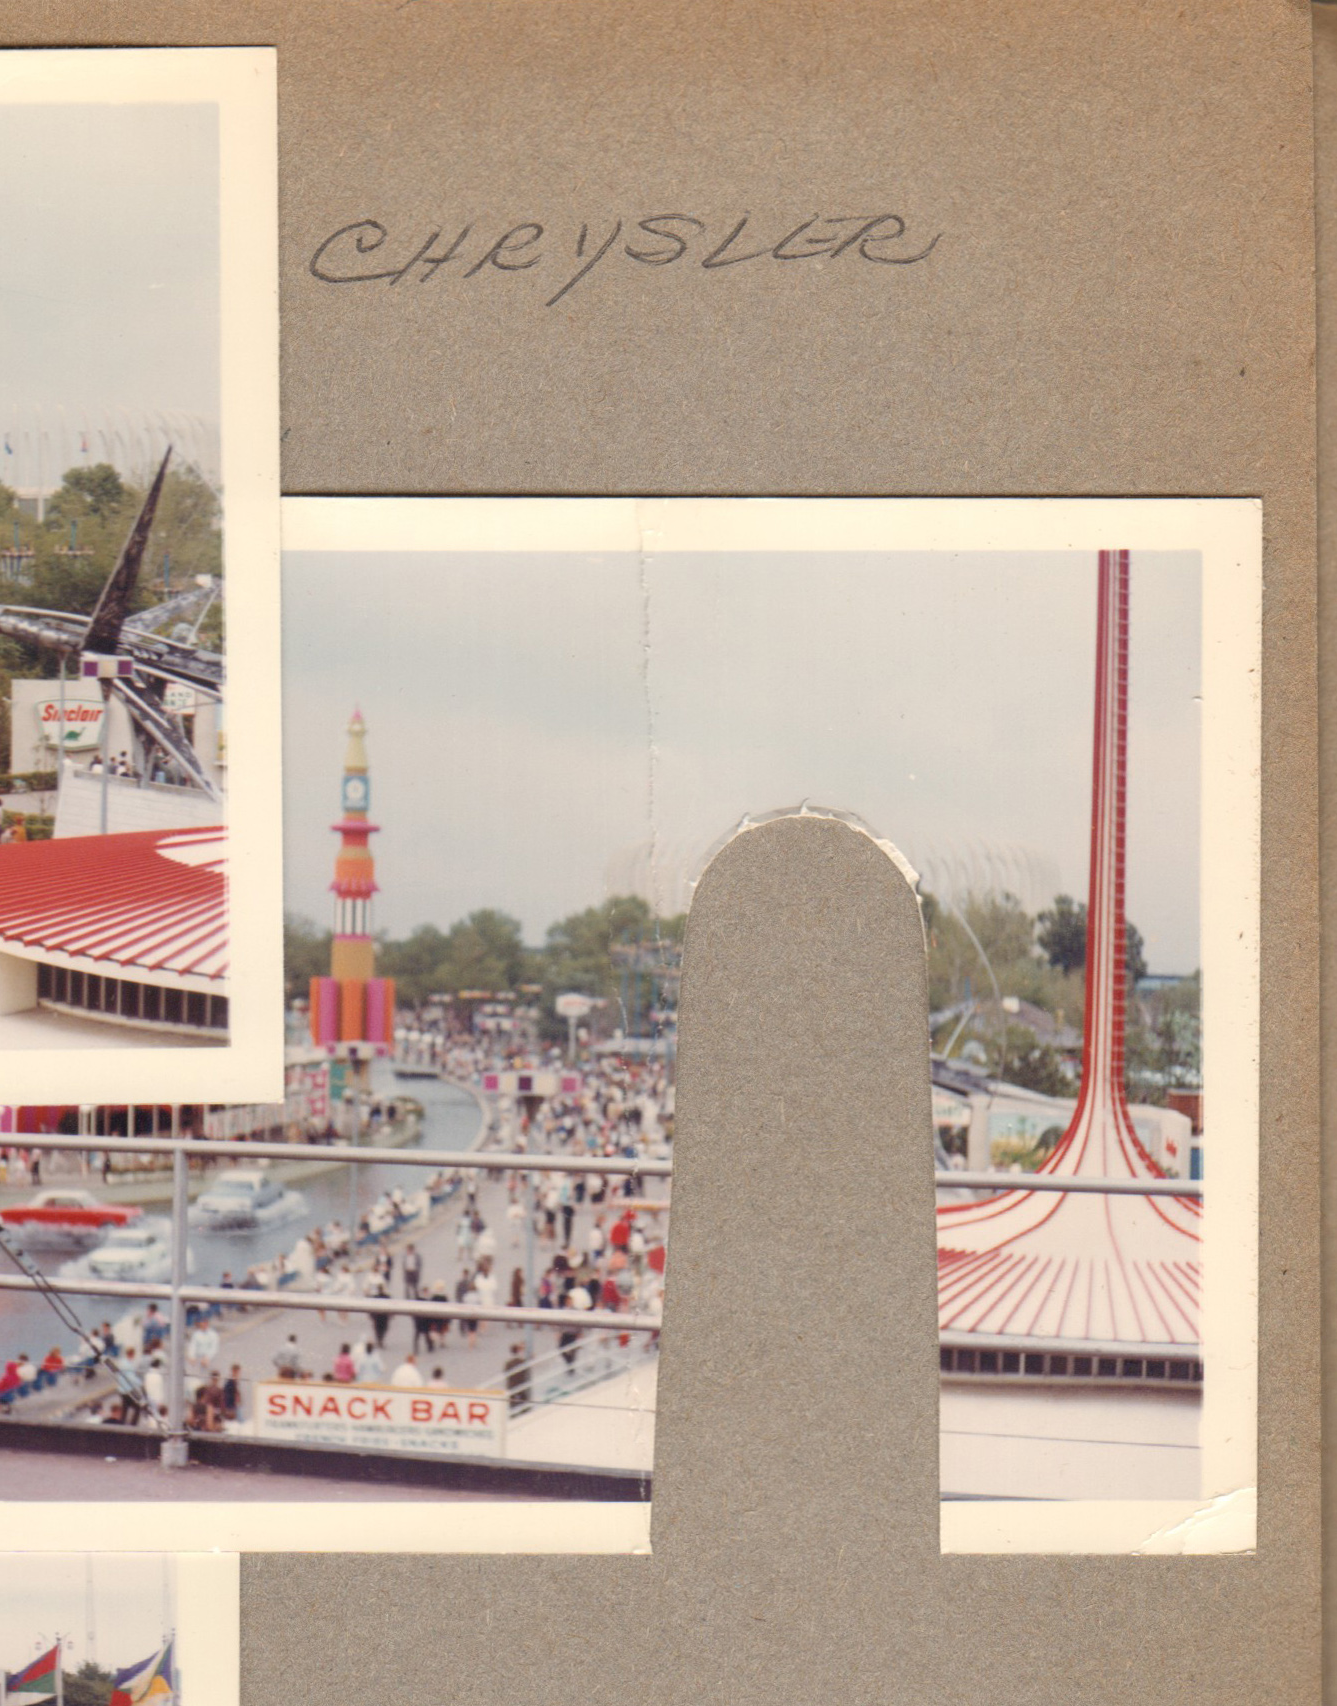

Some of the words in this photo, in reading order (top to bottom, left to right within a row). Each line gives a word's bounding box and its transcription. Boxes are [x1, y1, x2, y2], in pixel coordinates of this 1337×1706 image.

[309, 212, 943, 307] CHRYSLER
[268, 1394, 393, 1421] SNACK
[411, 1399, 490, 1425] BAR
